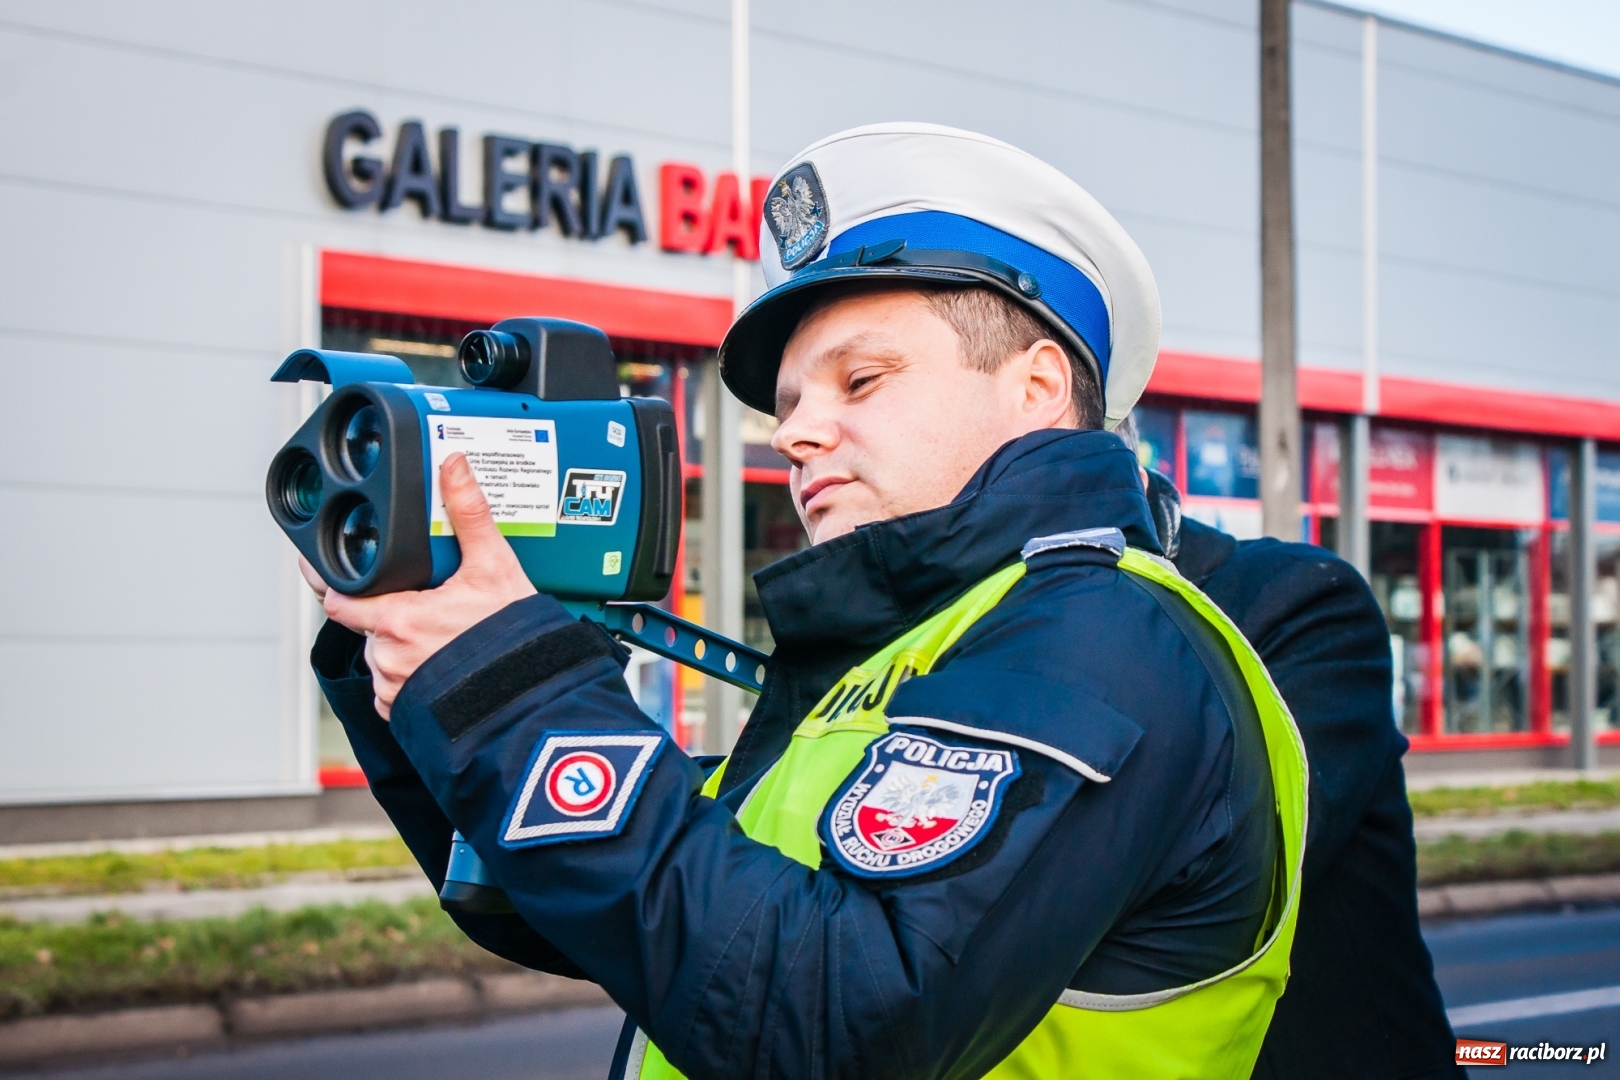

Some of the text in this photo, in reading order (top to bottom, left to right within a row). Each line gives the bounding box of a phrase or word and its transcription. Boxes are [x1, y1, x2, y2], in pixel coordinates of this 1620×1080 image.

[323, 108, 648, 245] GALERIA
[563, 496, 612, 517] CAM
[885, 737, 1003, 772] POLICJA
[564, 767, 596, 796] R
[842, 836, 891, 867] RUCHU
[896, 799, 988, 865] DROGOWEGO
